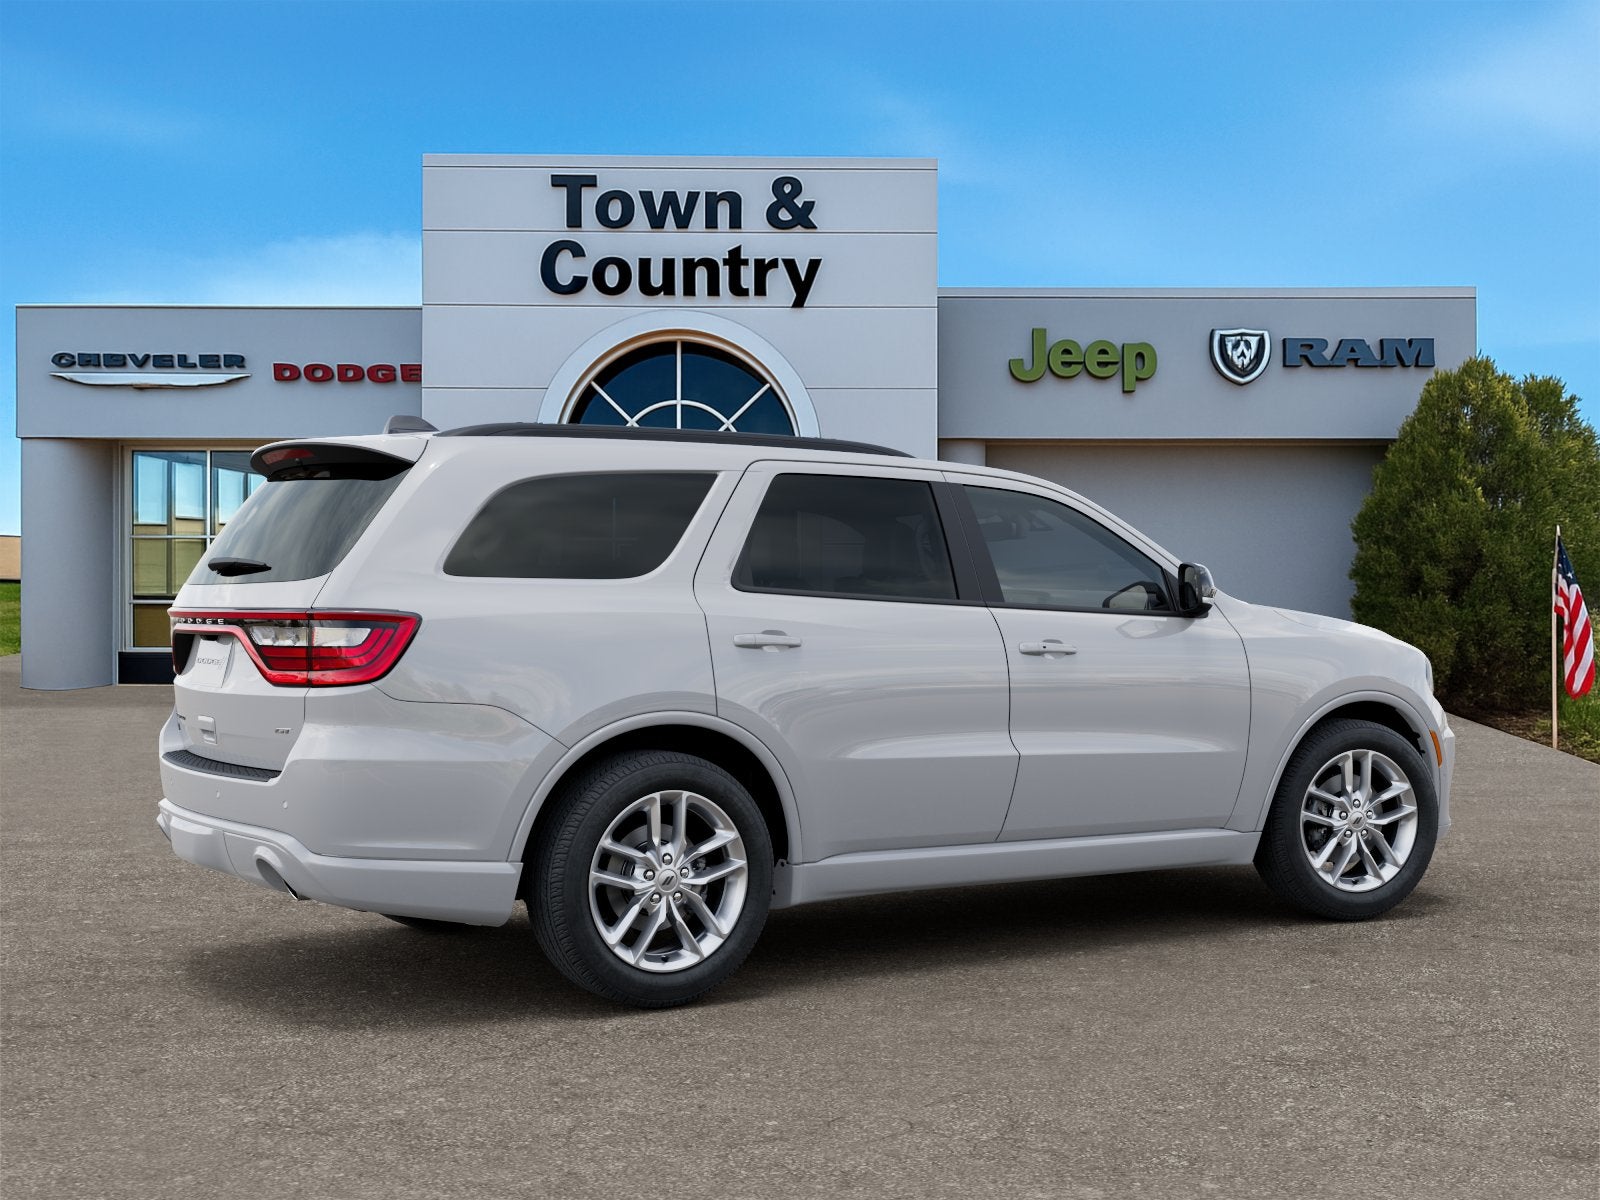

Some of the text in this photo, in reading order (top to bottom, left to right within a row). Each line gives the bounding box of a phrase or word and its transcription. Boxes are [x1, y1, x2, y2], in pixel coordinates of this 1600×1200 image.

[551, 174, 818, 230] Town &
[540, 239, 822, 308] Country
[273, 363, 422, 383] DODGE
[1008, 328, 1157, 393] Jeep
[1282, 337, 1435, 368] RAM
